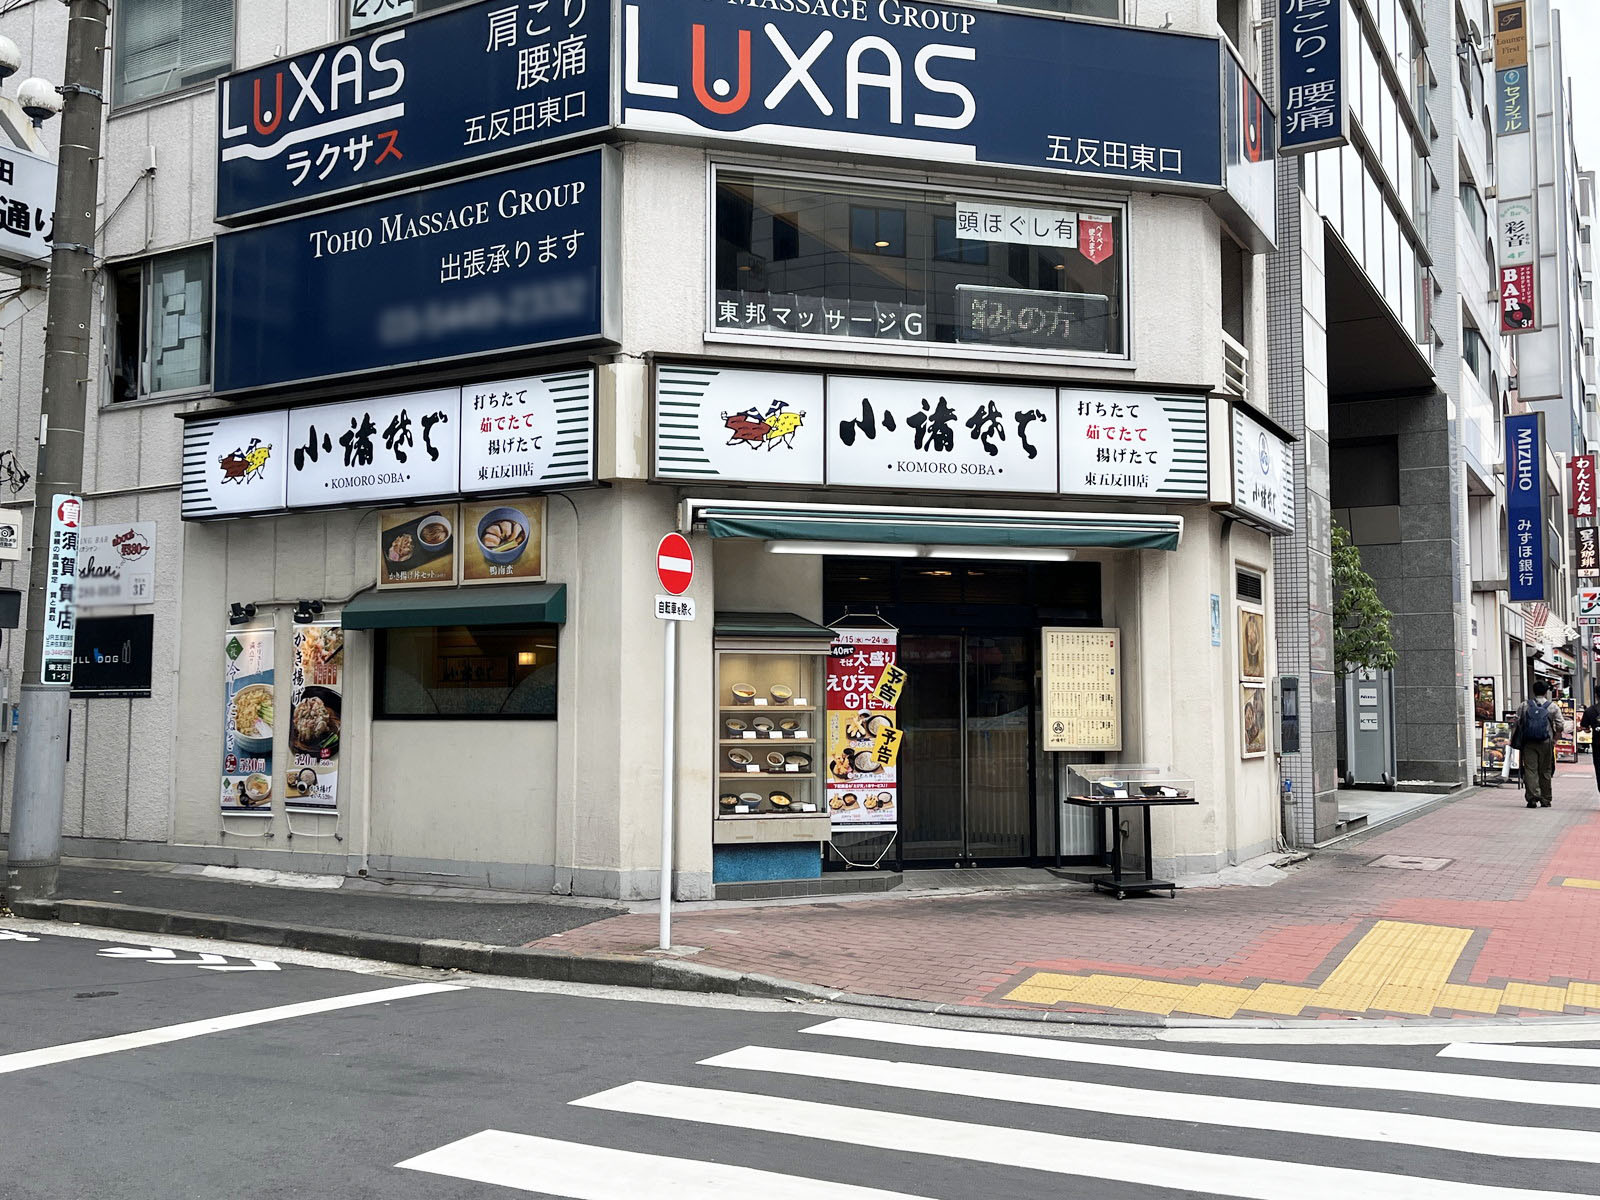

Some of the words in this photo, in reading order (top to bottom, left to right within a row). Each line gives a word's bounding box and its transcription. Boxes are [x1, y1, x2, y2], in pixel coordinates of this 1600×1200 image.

[516, 34, 588, 91] 腰痛
[624, 4, 977, 130] LUXAS
[222, 29, 406, 139] LUXAS
[463, 91, 587, 147] 五反田東口
[1504, 85, 1522, 132] セイシェル
[286, 129, 404, 187] ラクサス
[1046, 134, 1184, 174] 五反田東口
[309, 226, 373, 260] TOHO
[380, 201, 490, 245] MASSAGE
[498, 180, 586, 220] GROUP
[957, 211, 1075, 240] 頭ほぐし有
[440, 229, 586, 284] 出張承ります
[1503, 268, 1520, 312] BAR
[473, 389, 528, 410] 打ちたて
[1077, 400, 1139, 419] 打ちたて
[480, 413, 535, 434] 茹でたて
[1085, 423, 1148, 443] 茹でたて
[488, 434, 543, 457] 揚げたて
[1096, 446, 1159, 466] 揚げたて
[1517, 428, 1532, 491] MIZUHO
[330, 474, 376, 490] KOMORO
[377, 472, 405, 487] SOBA
[478, 461, 535, 482] 東五反田店
[896, 460, 958, 476] KOMORO
[960, 463, 996, 478] SOBA
[1083, 472, 1149, 489] 東五反田店
[1517, 519, 1534, 586] みずほ銀行
[56, 530, 78, 630] 須賀質店
[658, 601, 692, 616] 自転車を除く
[97, 655, 119, 663] DOG
[292, 631, 306, 706] かき揚げ
[858, 666, 865, 674] と
[826, 674, 875, 692] えび天
[879, 667, 904, 703] 予告
[877, 728, 897, 764] 予告
